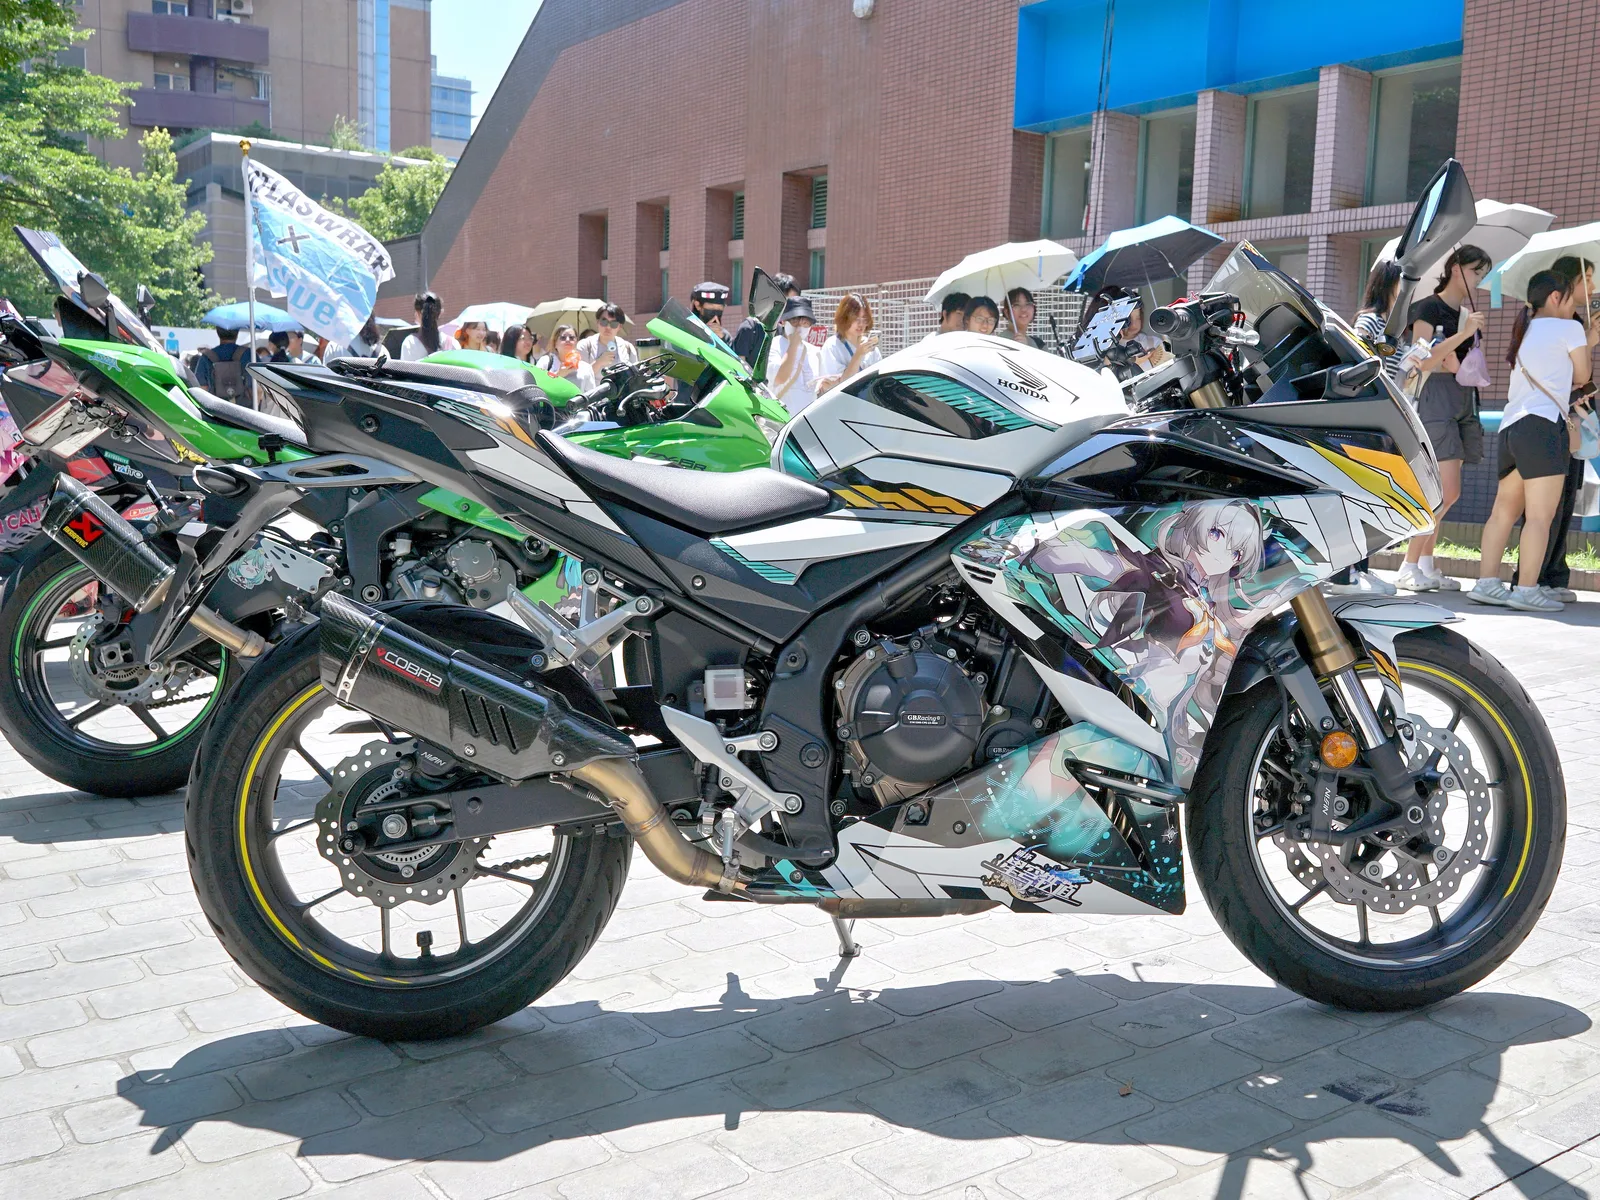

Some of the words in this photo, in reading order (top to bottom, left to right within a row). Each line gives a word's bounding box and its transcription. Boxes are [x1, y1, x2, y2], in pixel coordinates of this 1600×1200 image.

[997, 377, 1051, 403] HONDA
[113, 461, 144, 479] TAITO
[384, 651, 443, 688] COBRA
